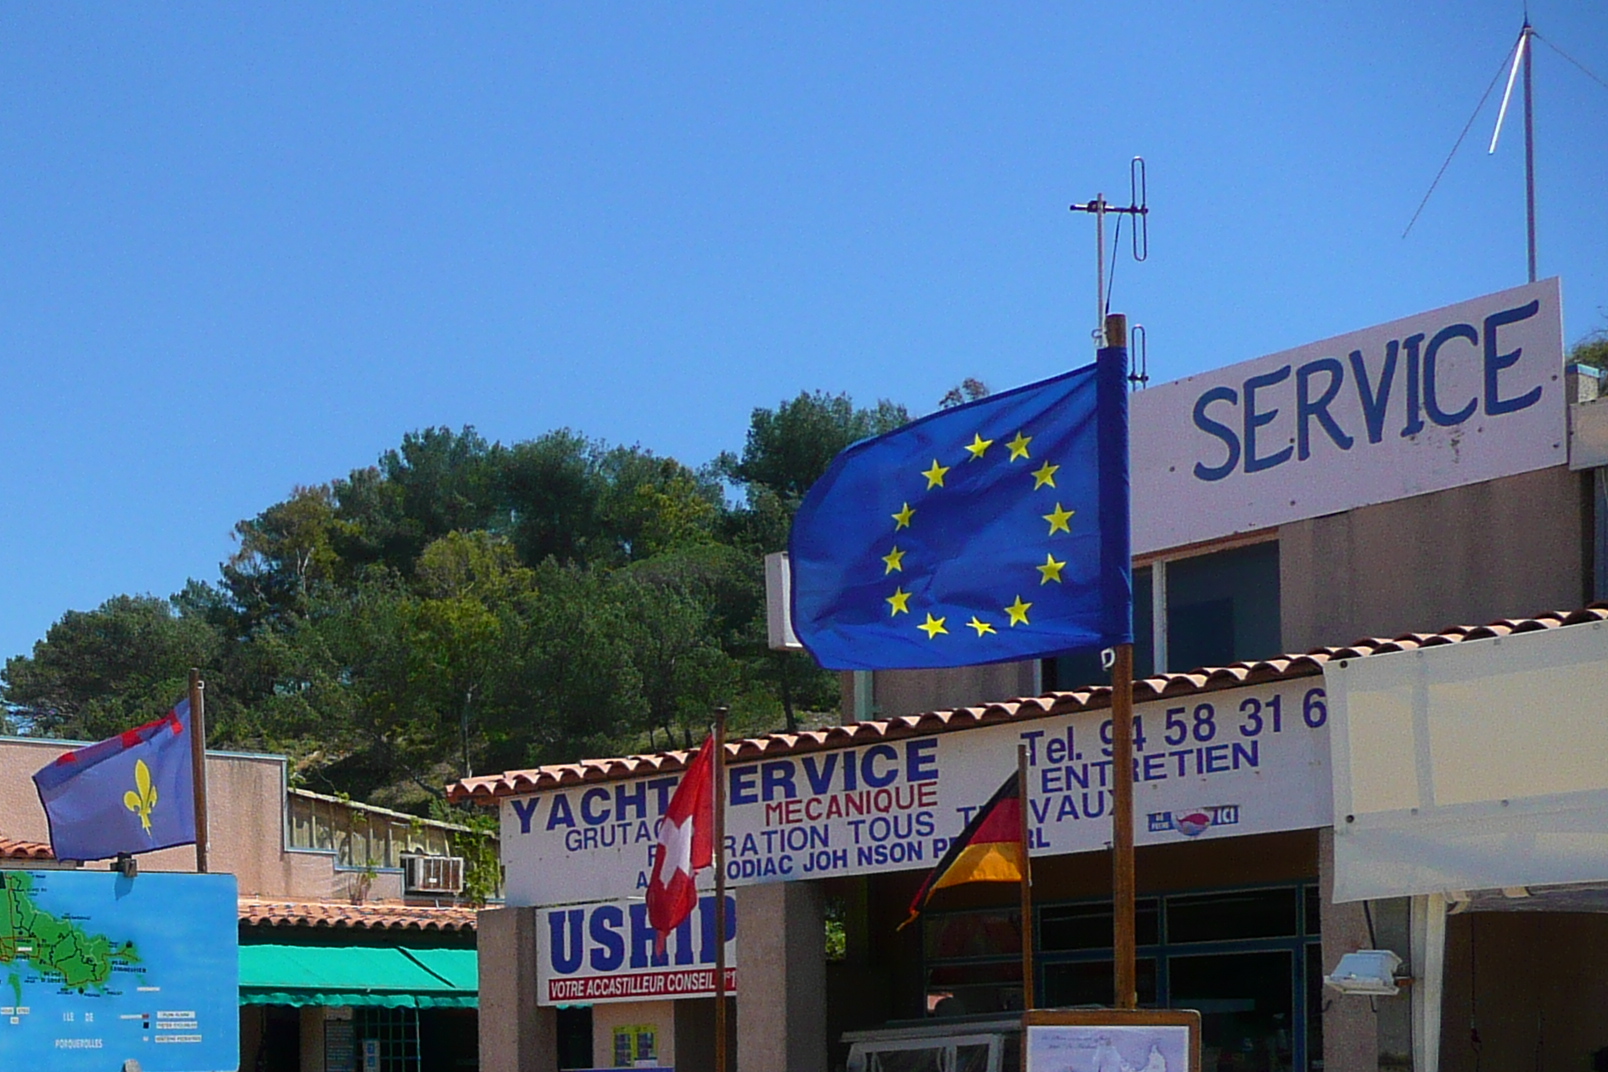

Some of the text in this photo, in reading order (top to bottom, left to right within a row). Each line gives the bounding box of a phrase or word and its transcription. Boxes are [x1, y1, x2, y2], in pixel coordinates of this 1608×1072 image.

[1192, 299, 1543, 482] SERVICE
[1020, 725, 1083, 768] Tel.
[1164, 703, 1217, 747] 58
[1239, 693, 1282, 737] 31
[510, 738, 940, 835] YACHT ERVICE
[765, 780, 939, 828] MECANIQUE
[847, 810, 935, 845] TOUS
[725, 853, 793, 881] ODIAC
[548, 895, 737, 975] USHIP
[550, 979, 585, 998] VOTRE
[586, 975, 665, 997] ACCASTILLEUR
[667, 971, 716, 992] CONSEIL
[63, 1011, 94, 1023] ILE DE
